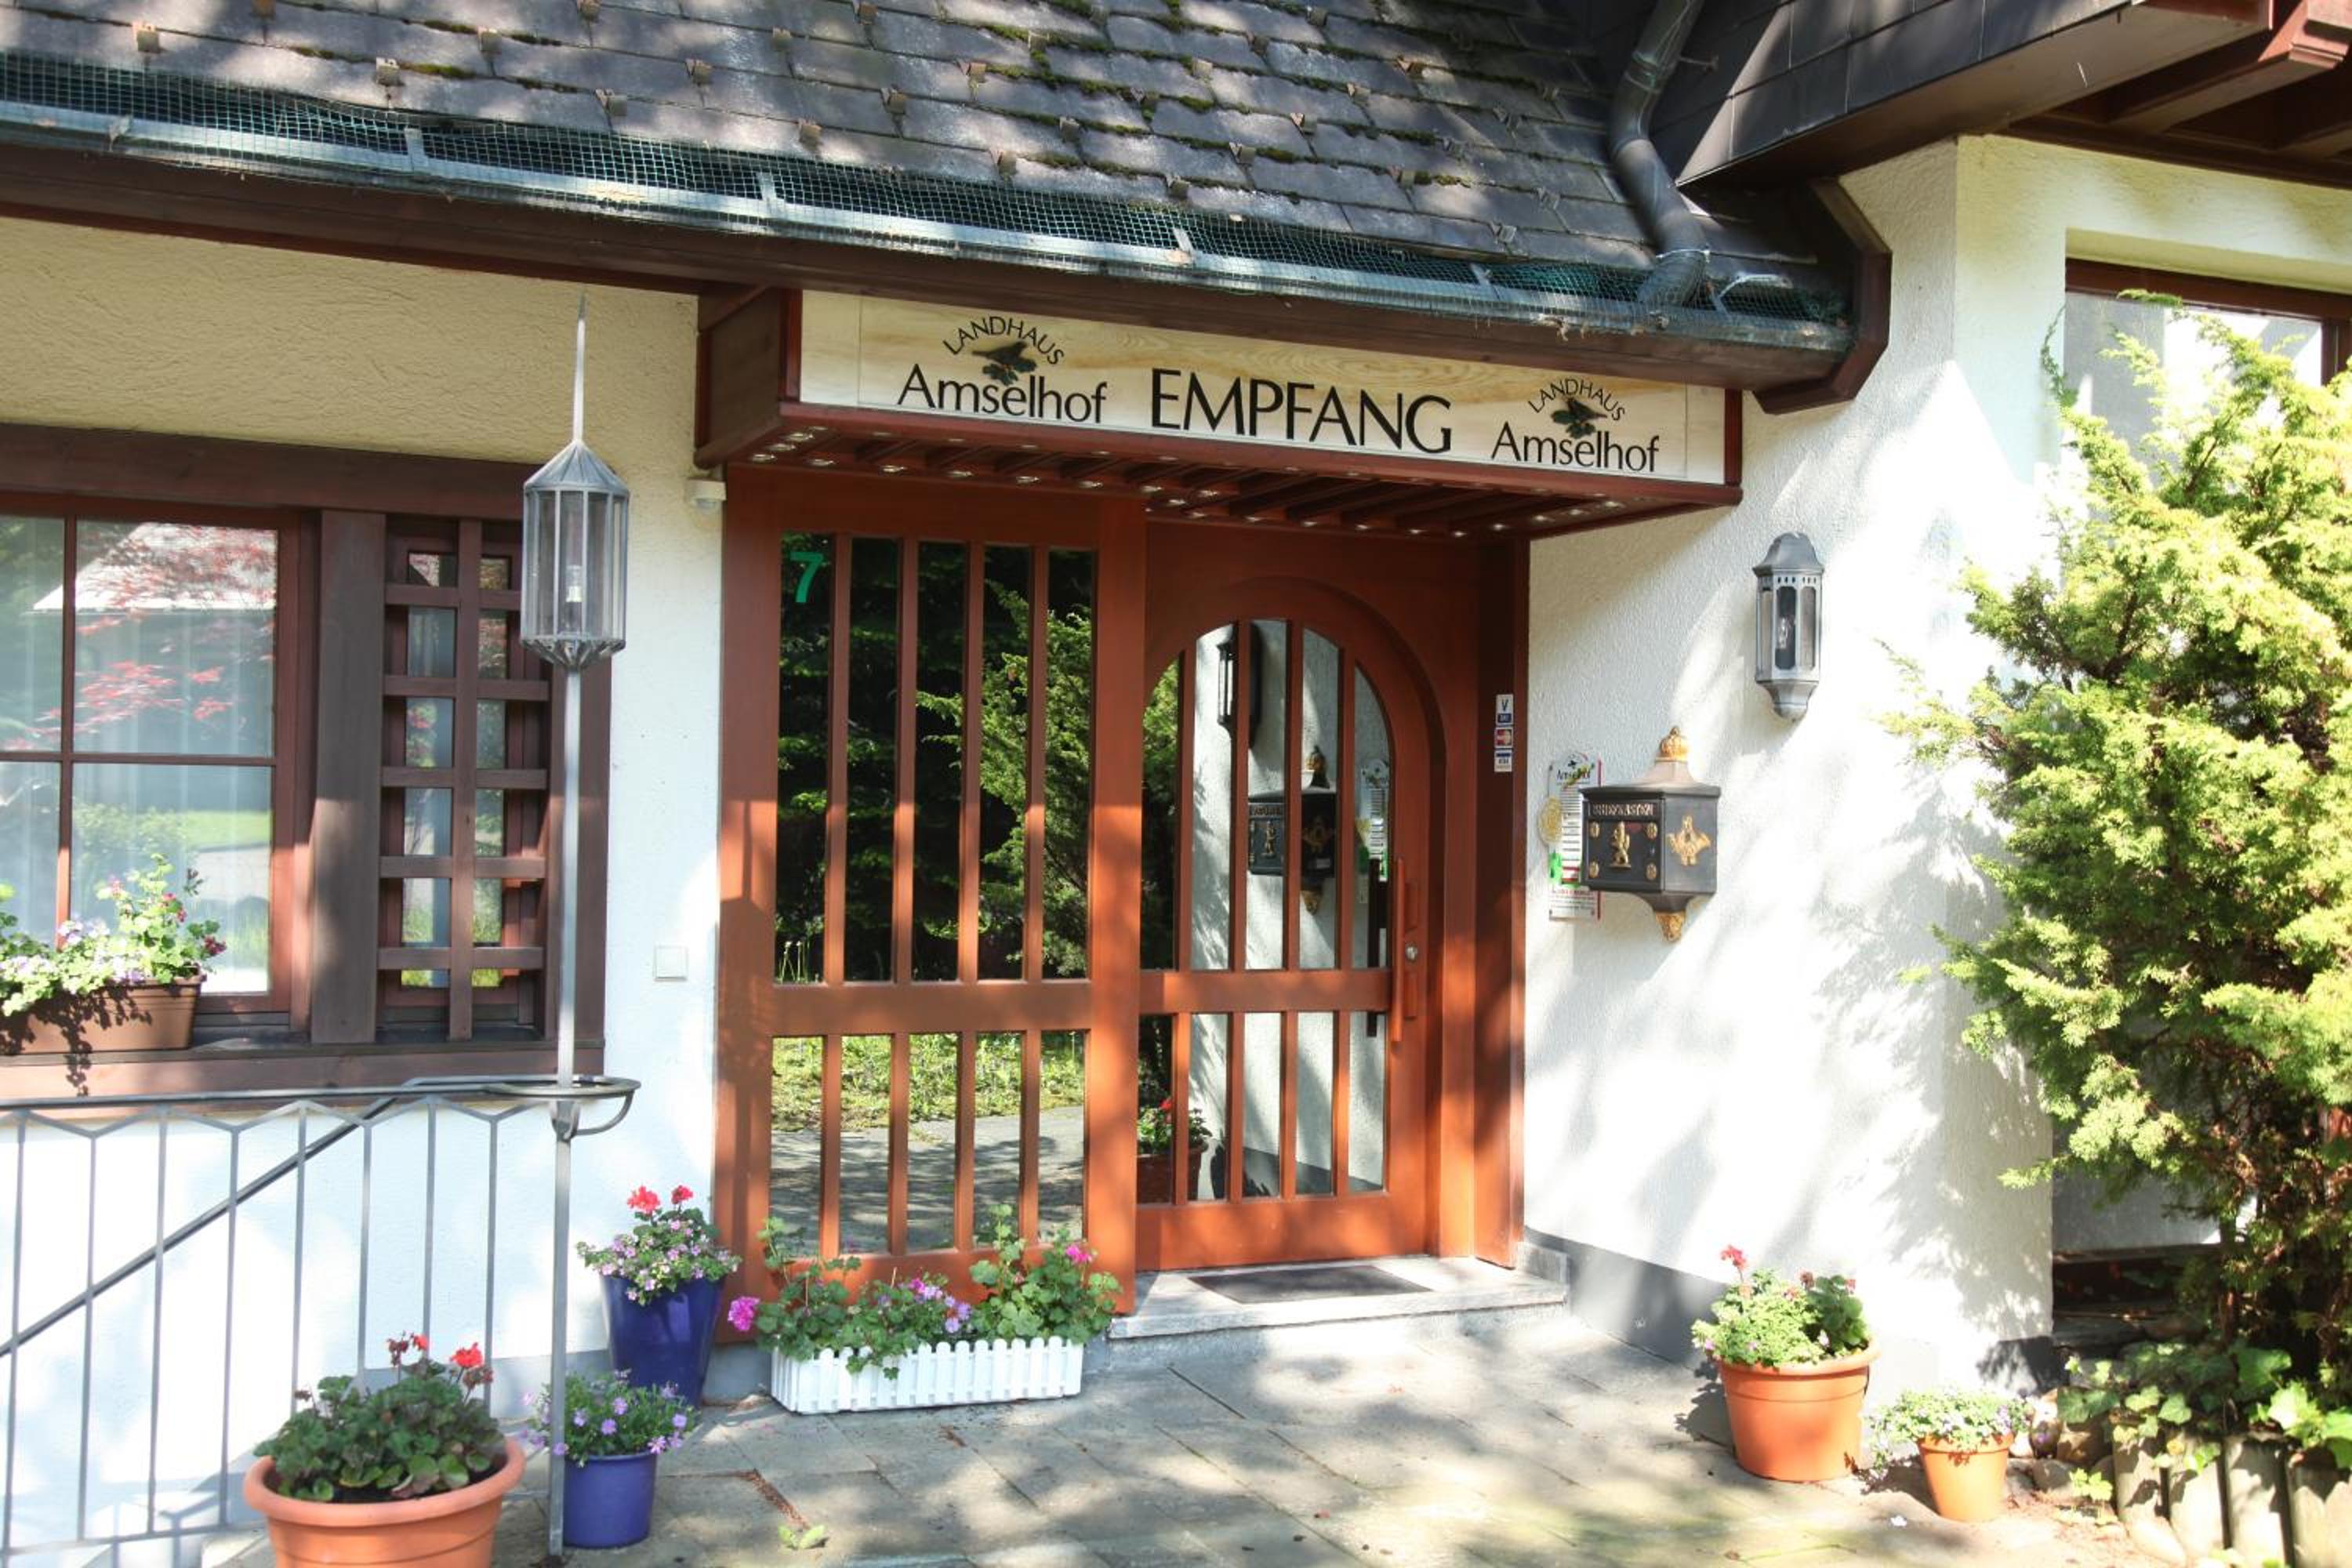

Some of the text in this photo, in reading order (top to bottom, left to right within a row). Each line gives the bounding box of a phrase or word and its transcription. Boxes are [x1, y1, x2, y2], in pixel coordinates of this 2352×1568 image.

[942, 316, 1064, 365] LANDHAUS
[897, 363, 1107, 423] Amselhof
[1152, 368, 1451, 453] EMPFANG
[1528, 379, 1625, 421] LANDHAUS
[1491, 421, 1659, 472] Amselhof
[790, 551, 823, 603] 7
